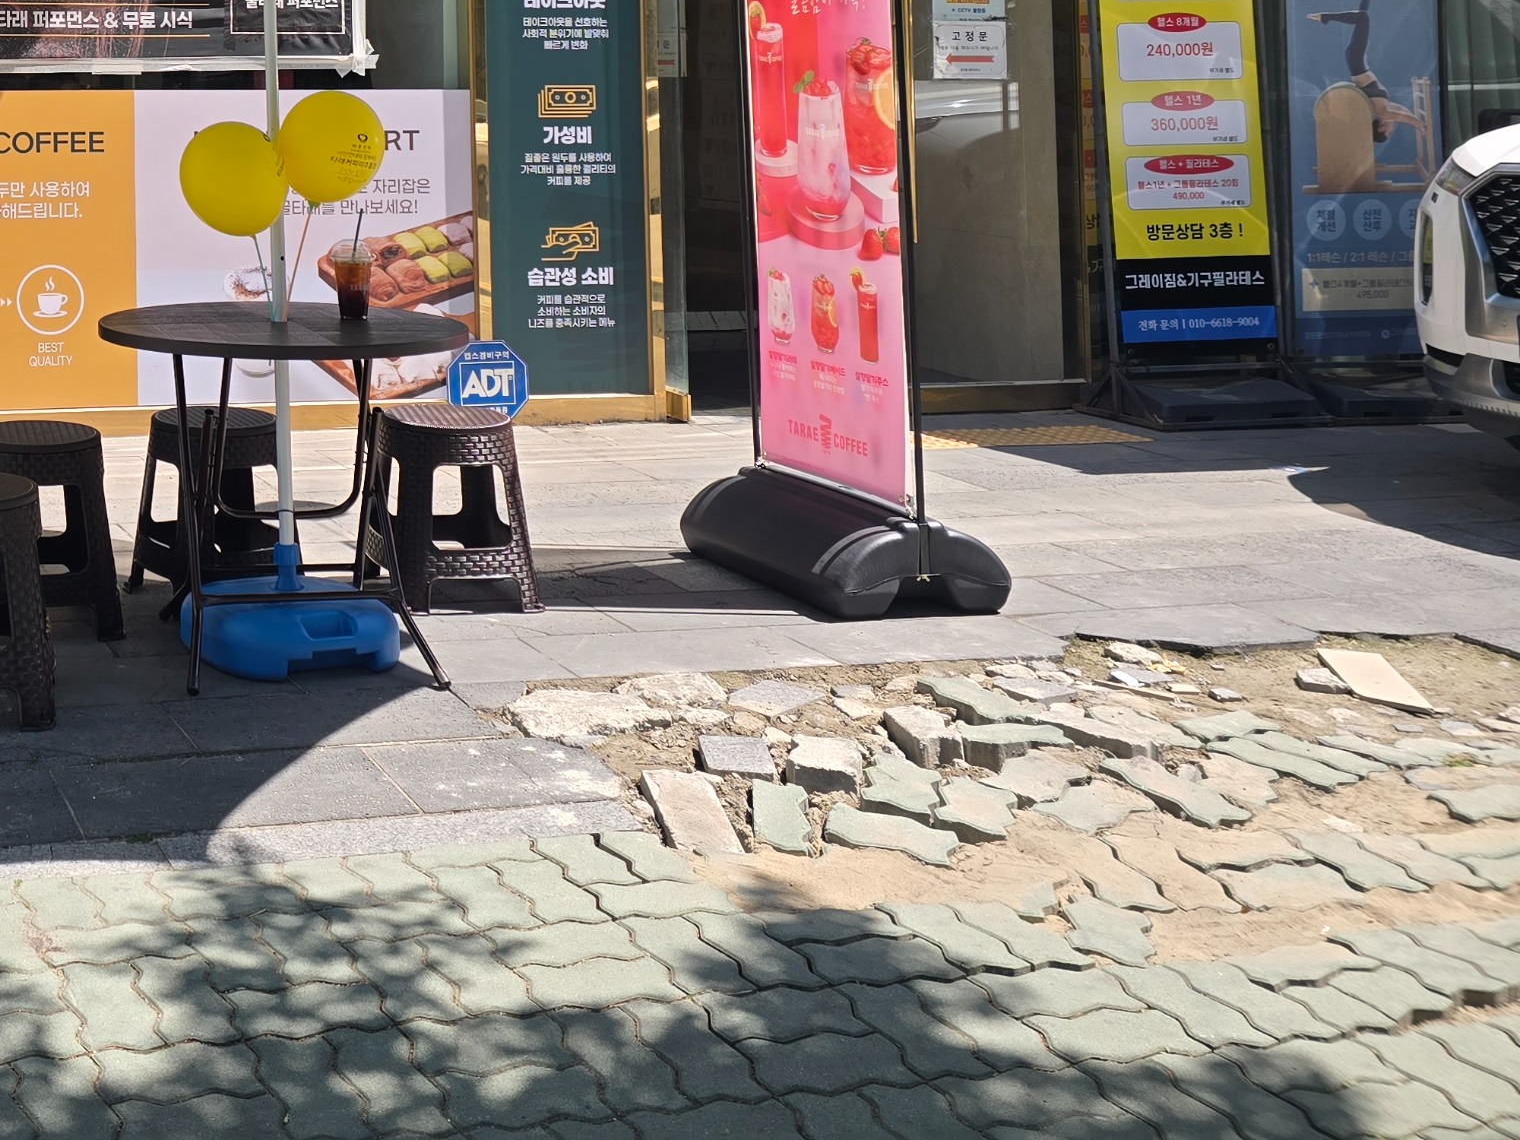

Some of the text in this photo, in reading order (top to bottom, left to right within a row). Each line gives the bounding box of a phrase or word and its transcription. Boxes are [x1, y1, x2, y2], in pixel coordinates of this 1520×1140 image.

[32, 10, 100, 29] 퍼포먼스
[103, 11, 119, 29] &
[122, 11, 157, 29] 무료
[160, 11, 194, 30] 시식
[1176, 15, 1200, 27] 8개월
[1146, 41, 1215, 59] 240,000원
[1185, 94, 1202, 106] 1년
[1150, 115, 1219, 133] 360,000원
[542, 125, 593, 145] 가성비
[29, 180, 91, 199] 사용하여
[372, 178, 431, 194] 자리잡은
[340, 199, 418, 215] 만나보세요!
[1146, 222, 1205, 241] 방문상담
[1209, 221, 1234, 240] 3층
[527, 266, 615, 287] 습관성 소비
[1125, 270, 1266, 290] 그레이짐&기구필라테스
[1137, 319, 1158, 332] 전화
[1159, 318, 1180, 331] 문의
[37, 342, 65, 354] BEST
[28, 355, 73, 368] QUALITY
[461, 368, 514, 399] ADT
[787, 419, 868, 457] TARAE COFFEE
